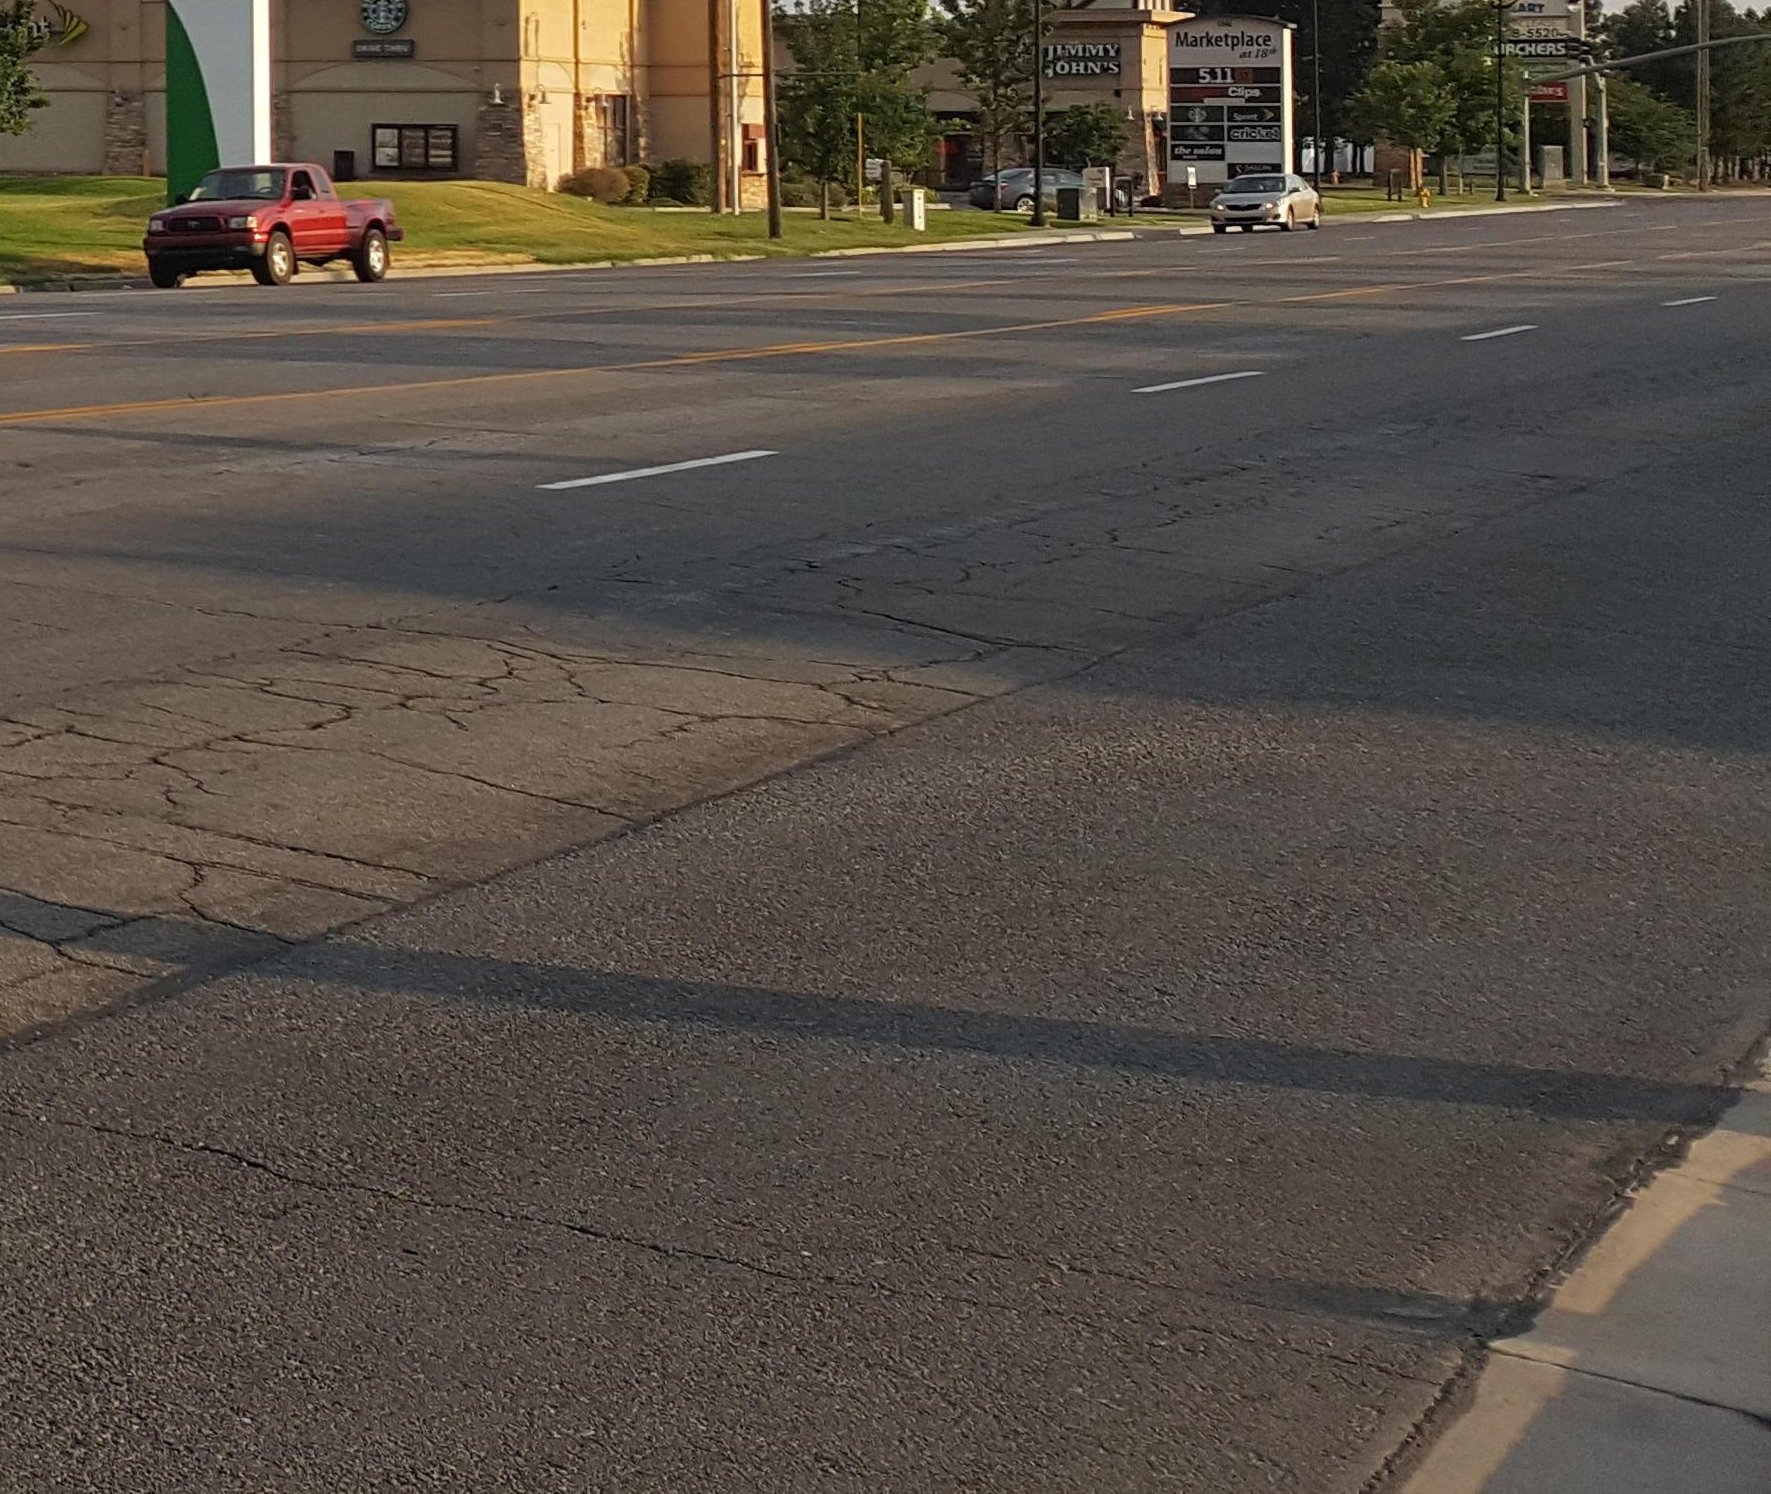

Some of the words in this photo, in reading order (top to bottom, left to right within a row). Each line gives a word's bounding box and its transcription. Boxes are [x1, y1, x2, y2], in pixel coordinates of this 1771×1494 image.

[1175, 30, 1272, 51] Marketplace
[1043, 44, 1120, 60] JIMMY
[1239, 50, 1251, 59] at
[1044, 61, 1120, 78] JOHN'S
[1230, 126, 1280, 140] cricket
